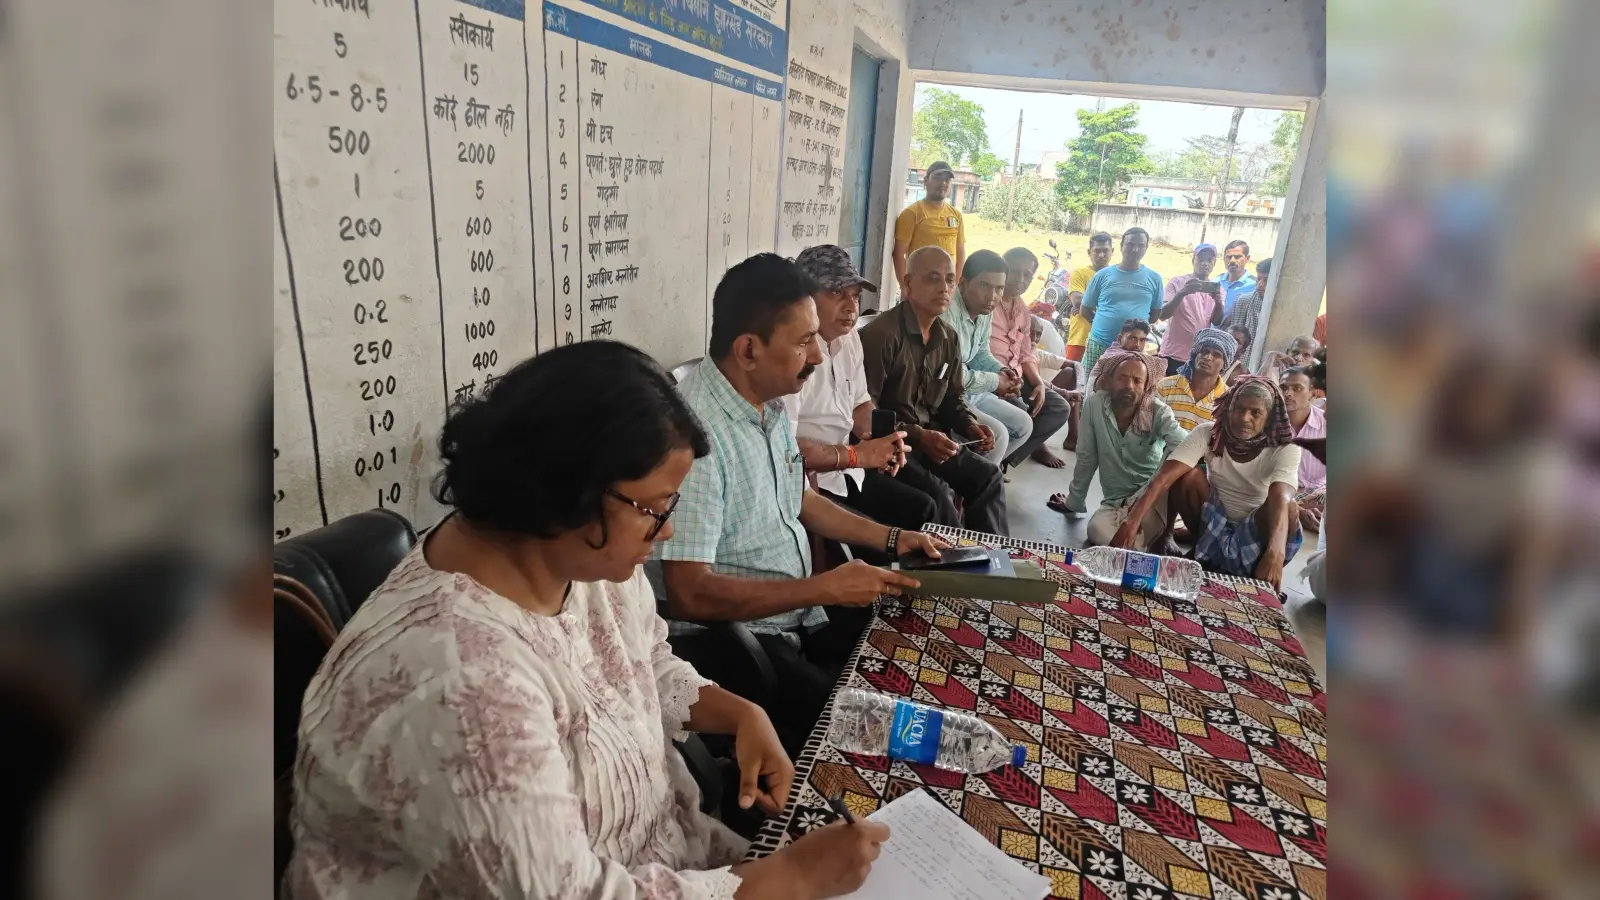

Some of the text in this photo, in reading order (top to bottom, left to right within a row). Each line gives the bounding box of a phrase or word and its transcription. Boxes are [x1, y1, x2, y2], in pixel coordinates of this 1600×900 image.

[333, 31, 348, 59] 5
[629, 37, 653, 58] मानक
[560, 50, 564, 71] 1
[463, 62, 480, 87] 15
[286, 72, 323, 104] 6.5
[349, 83, 388, 114] 8.5
[558, 83, 566, 103] 2
[433, 93, 459, 133] कोई
[464, 96, 491, 129] ढील
[328, 125, 371, 157] 500
[558, 118, 566, 139] 3
[586, 117, 614, 145] पी एच
[457, 141, 496, 166] 2000
[559, 151, 568, 170] 4
[354, 172, 361, 199] 1
[475, 179, 485, 201] 5
[560, 183, 568, 201] 5
[338, 215, 382, 242] 200
[465, 216, 492, 238] 600
[562, 215, 569, 233] 6
[470, 248, 494, 273] 600
[561, 243, 569, 263] 7
[342, 256, 385, 286] 200
[562, 274, 571, 296] 8
[353, 299, 389, 325] 0.2
[564, 302, 572, 321] 9
[464, 319, 496, 343] 1000
[353, 338, 393, 366] 250
[472, 349, 498, 372] 400
[359, 374, 397, 402] 200
[369, 409, 395, 437] 1.0
[354, 446, 397, 478] 0.01
[378, 482, 401, 508] 1.0
